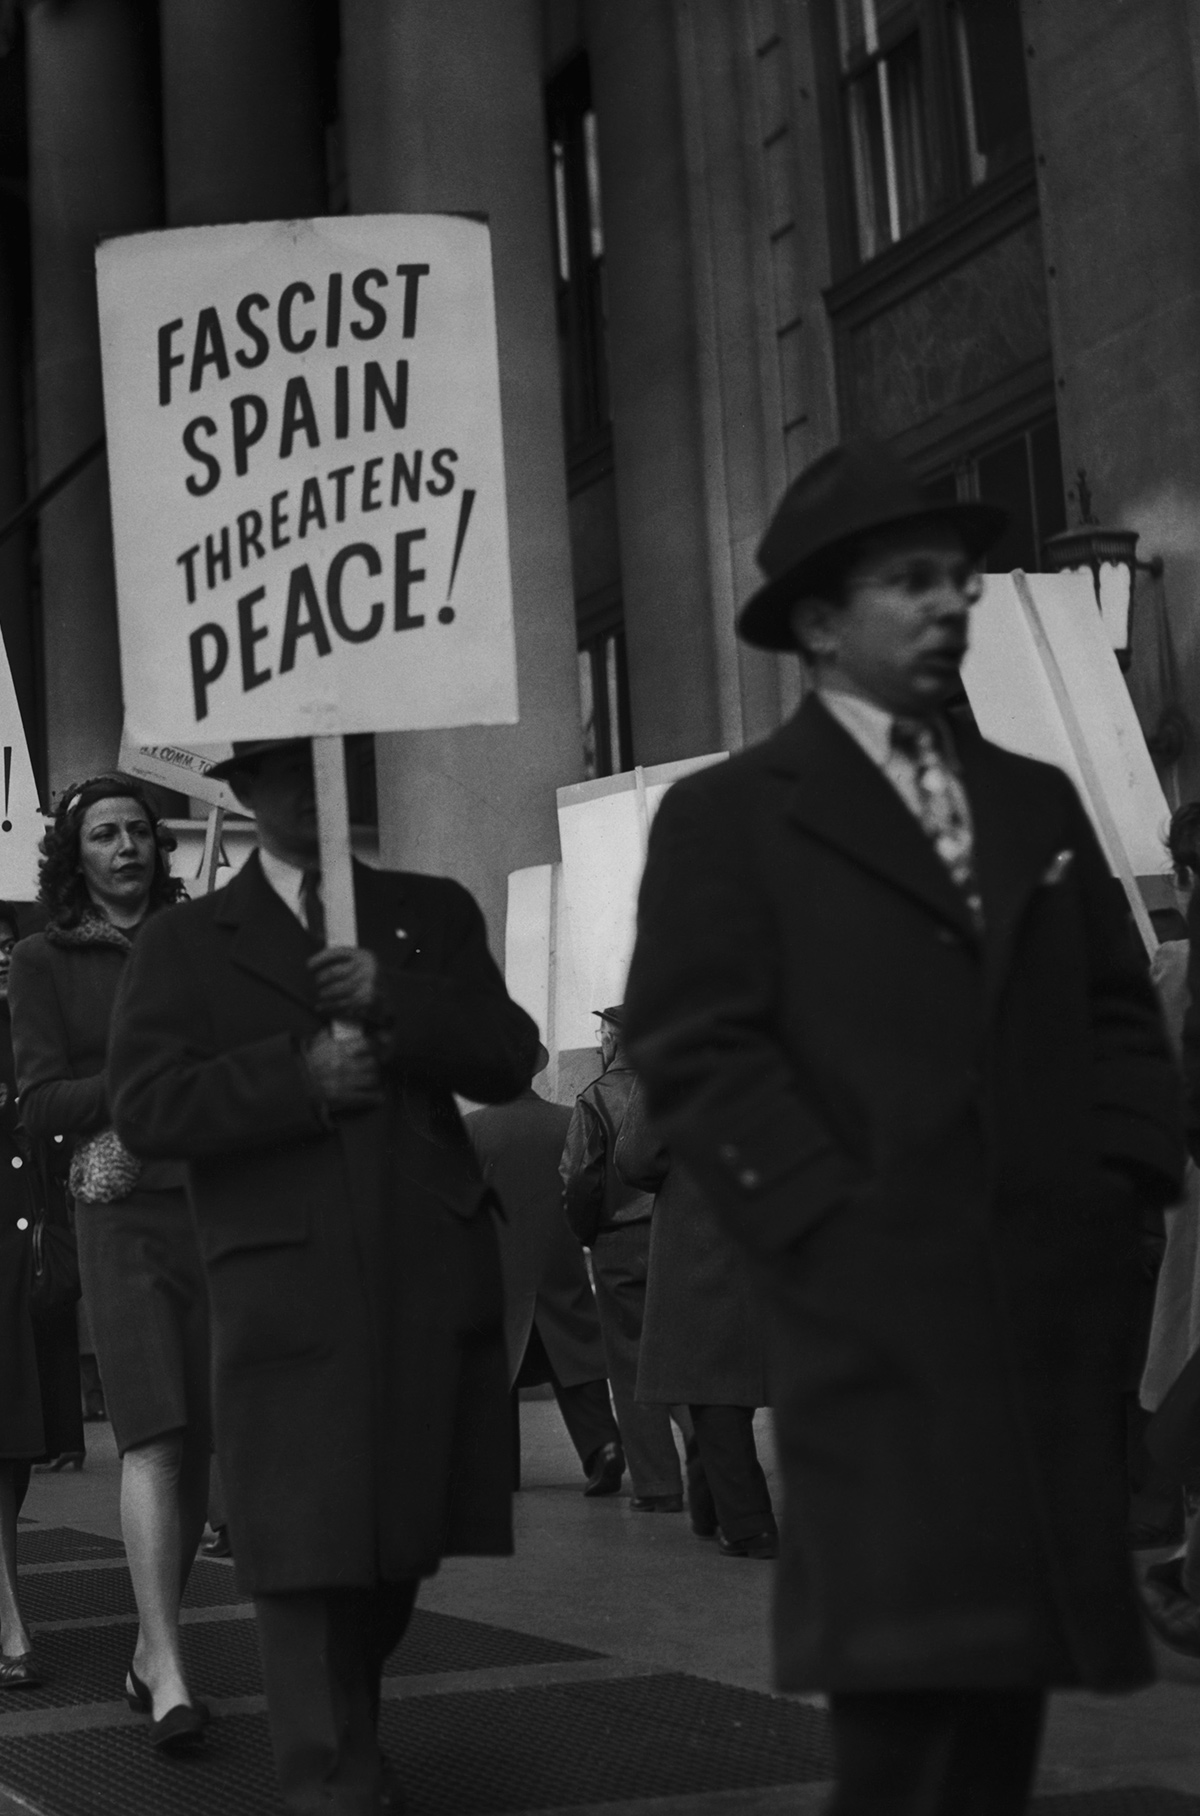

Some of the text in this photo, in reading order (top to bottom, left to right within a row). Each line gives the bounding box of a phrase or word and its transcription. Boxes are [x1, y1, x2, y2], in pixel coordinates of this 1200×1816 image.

[157, 263, 430, 407] FASCIST
[182, 359, 409, 497] SPAIN
[176, 448, 459, 604] THREATENS
[189, 489, 476, 722] PEACE!
